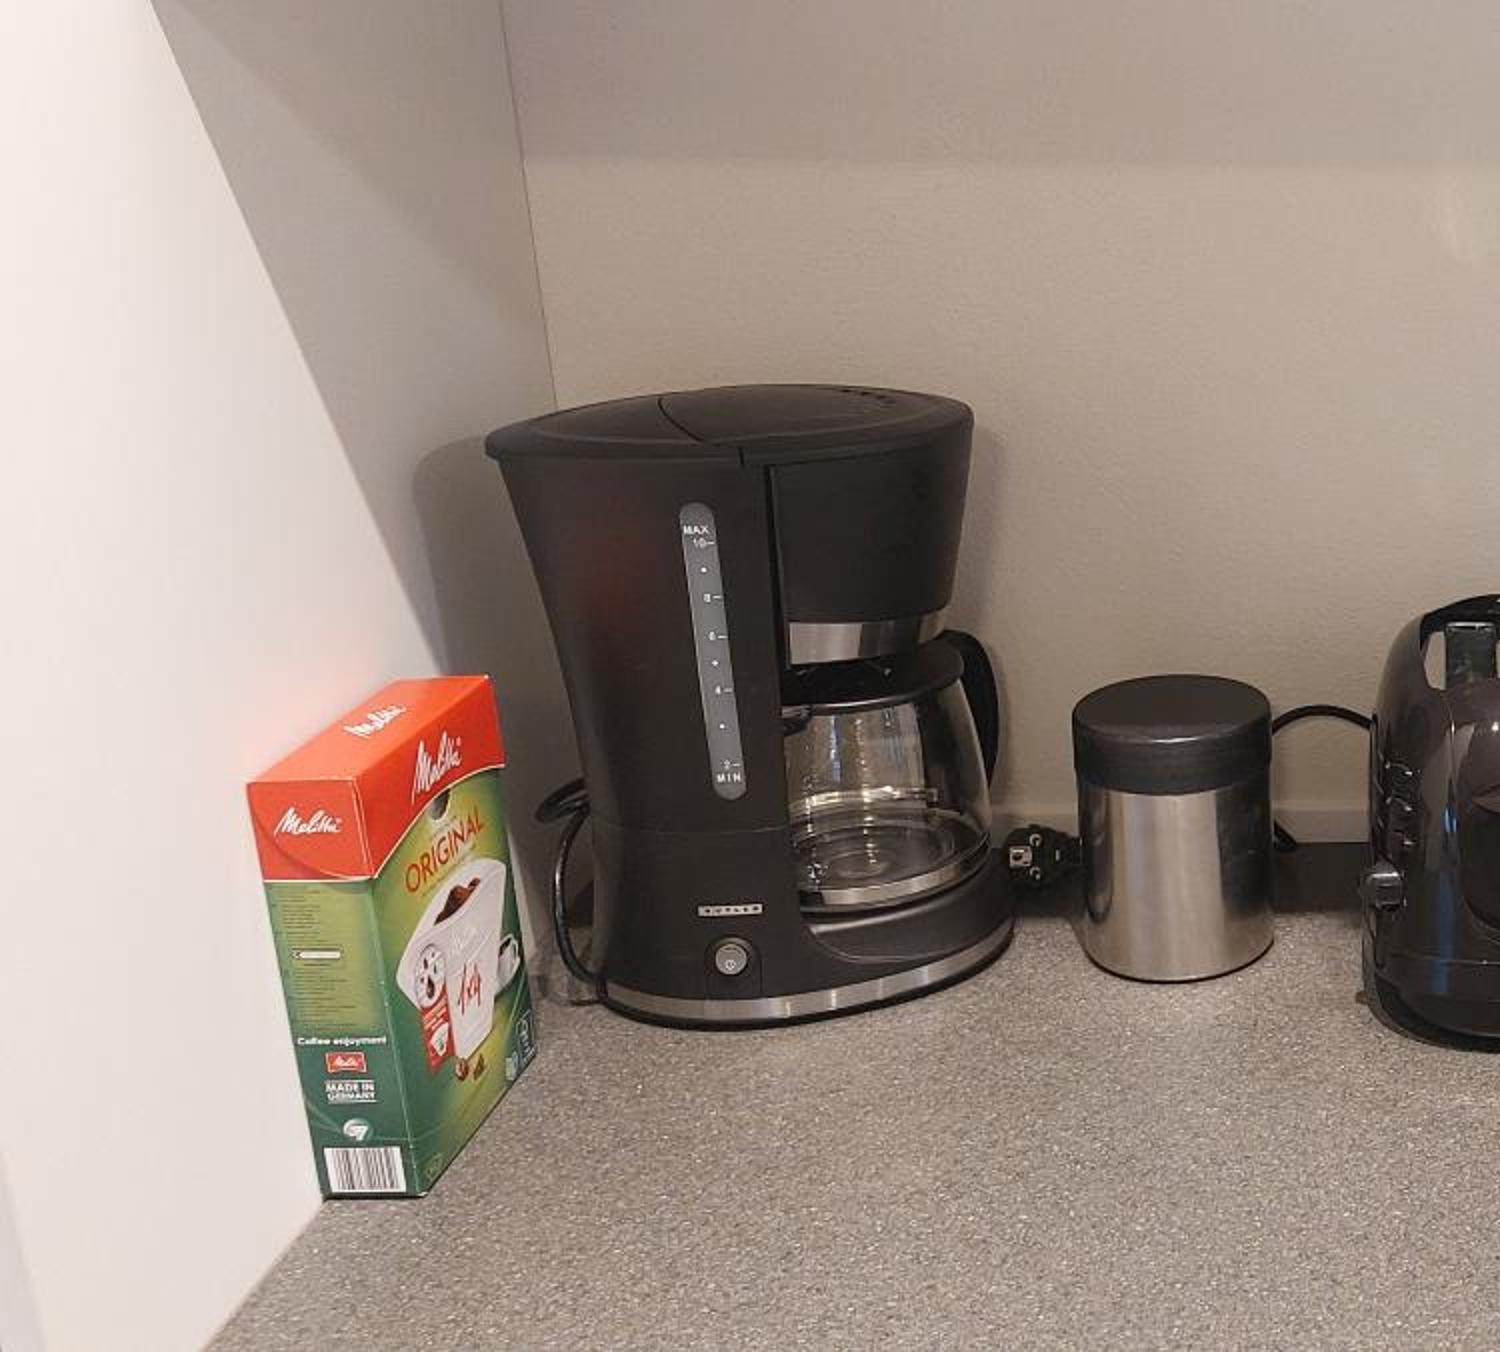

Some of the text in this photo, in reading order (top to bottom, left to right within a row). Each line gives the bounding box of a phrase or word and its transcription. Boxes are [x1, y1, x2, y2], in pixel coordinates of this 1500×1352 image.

[683, 524, 709, 535] MAX
[693, 538, 706, 548] 10
[703, 593, 712, 603] 8
[708, 631, 717, 641] 6
[714, 685, 722, 694] 4
[411, 731, 462, 804] Melitta
[723, 760, 731, 770] 2
[716, 772, 742, 784] MIN
[273, 806, 342, 836] Melitta
[405, 806, 486, 892] ORIGINAL
[325, 1082, 376, 1093] MADE IN
[327, 1092, 377, 1101] GERMANY
